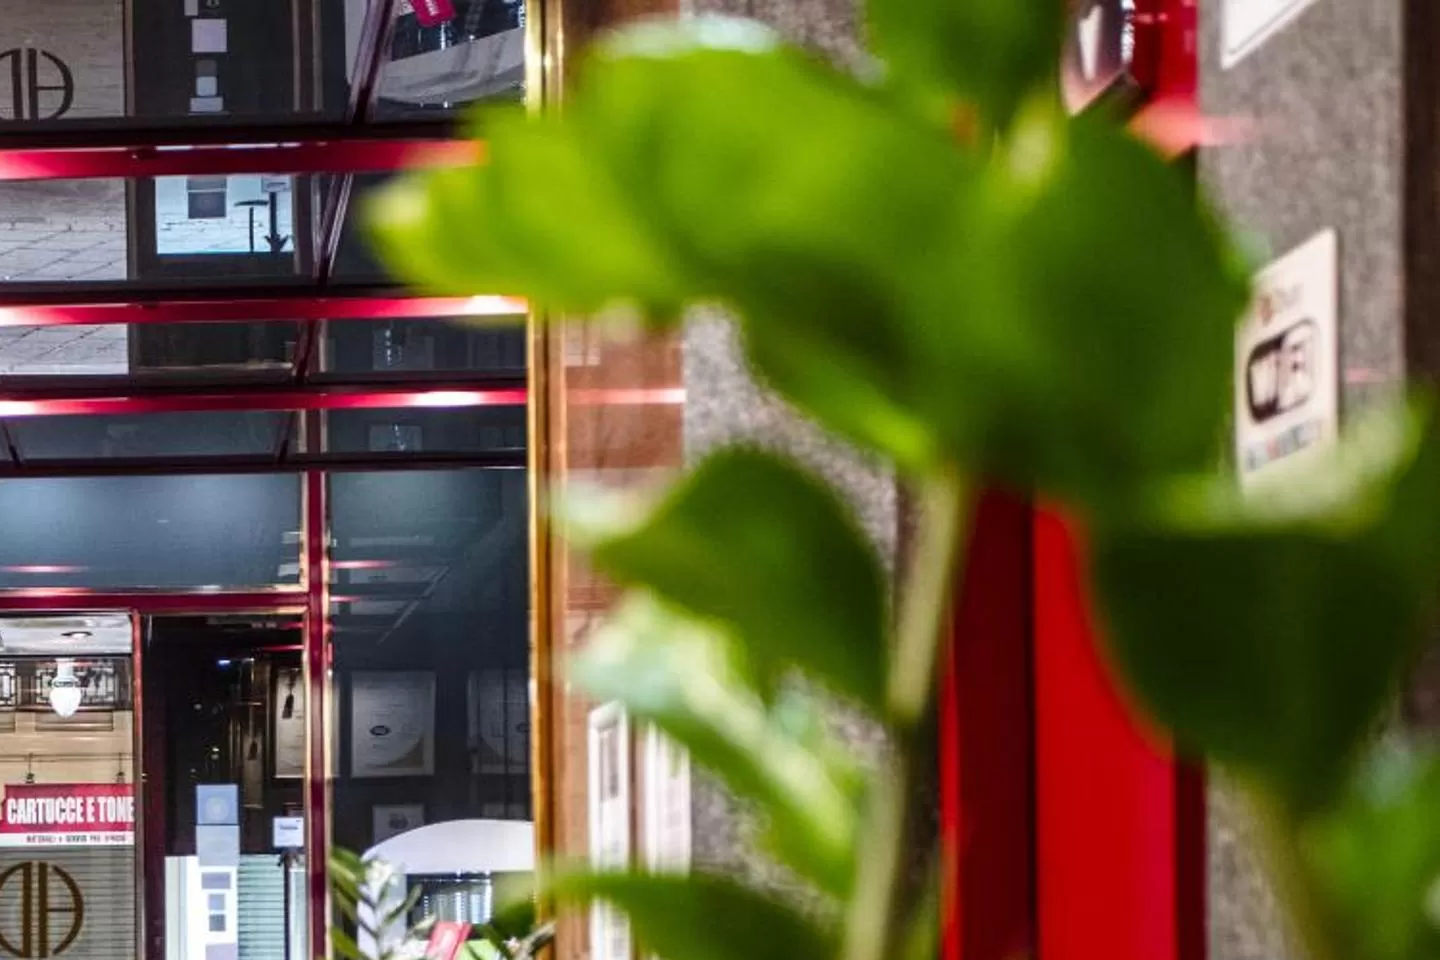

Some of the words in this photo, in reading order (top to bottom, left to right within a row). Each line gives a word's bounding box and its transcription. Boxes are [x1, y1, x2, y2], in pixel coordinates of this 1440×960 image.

[6, 797, 84, 826] CARTUCCE
[86, 797, 95, 823] E
[97, 795, 135, 823] TONE
